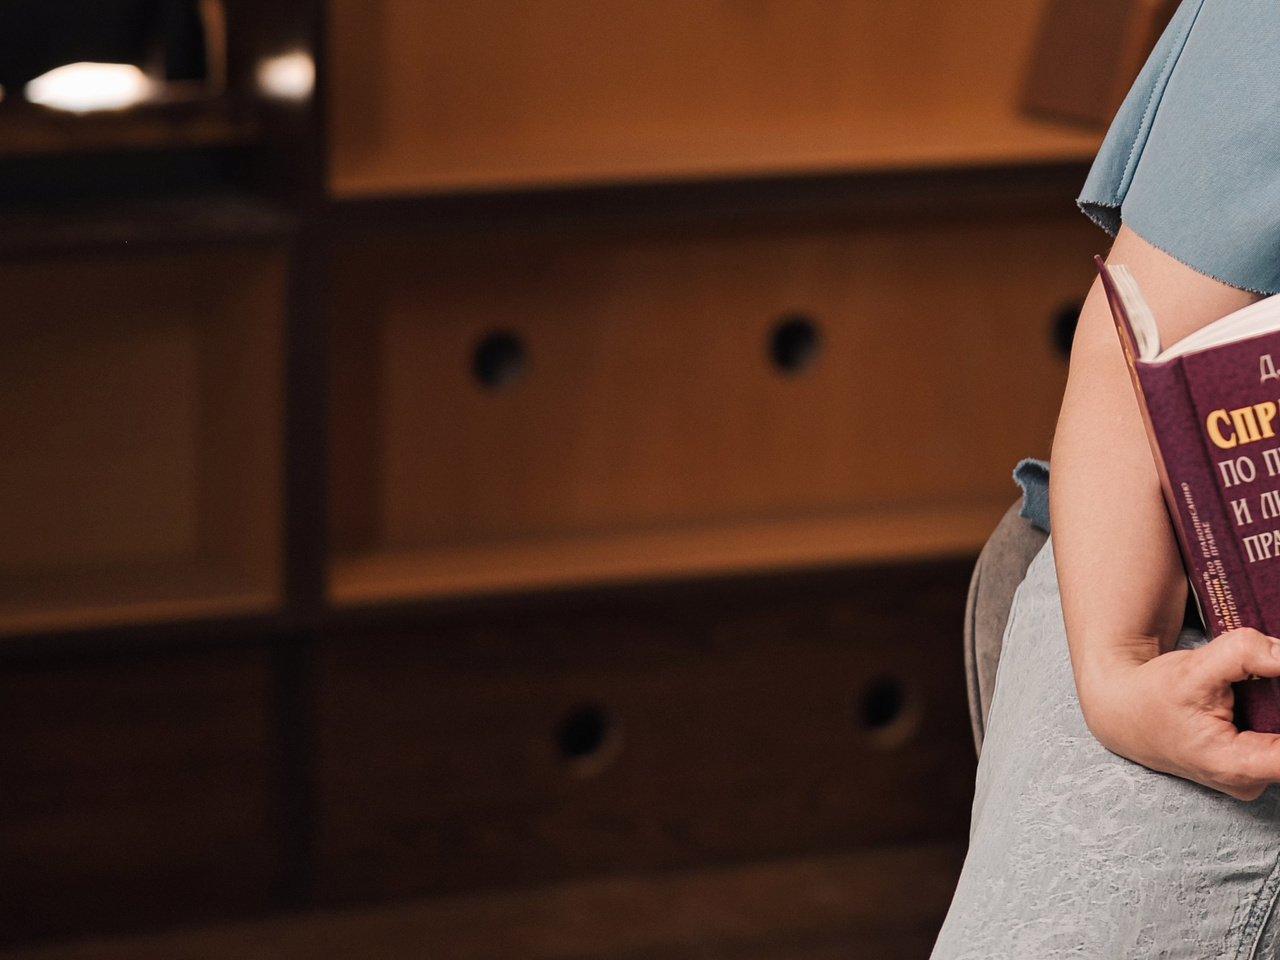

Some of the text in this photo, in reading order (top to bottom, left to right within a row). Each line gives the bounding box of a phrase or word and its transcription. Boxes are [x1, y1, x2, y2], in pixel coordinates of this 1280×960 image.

[1218, 456, 1257, 488] ПО
[1230, 497, 1254, 527] И
[1211, 577, 1235, 632] ПРАВОЧНИК
